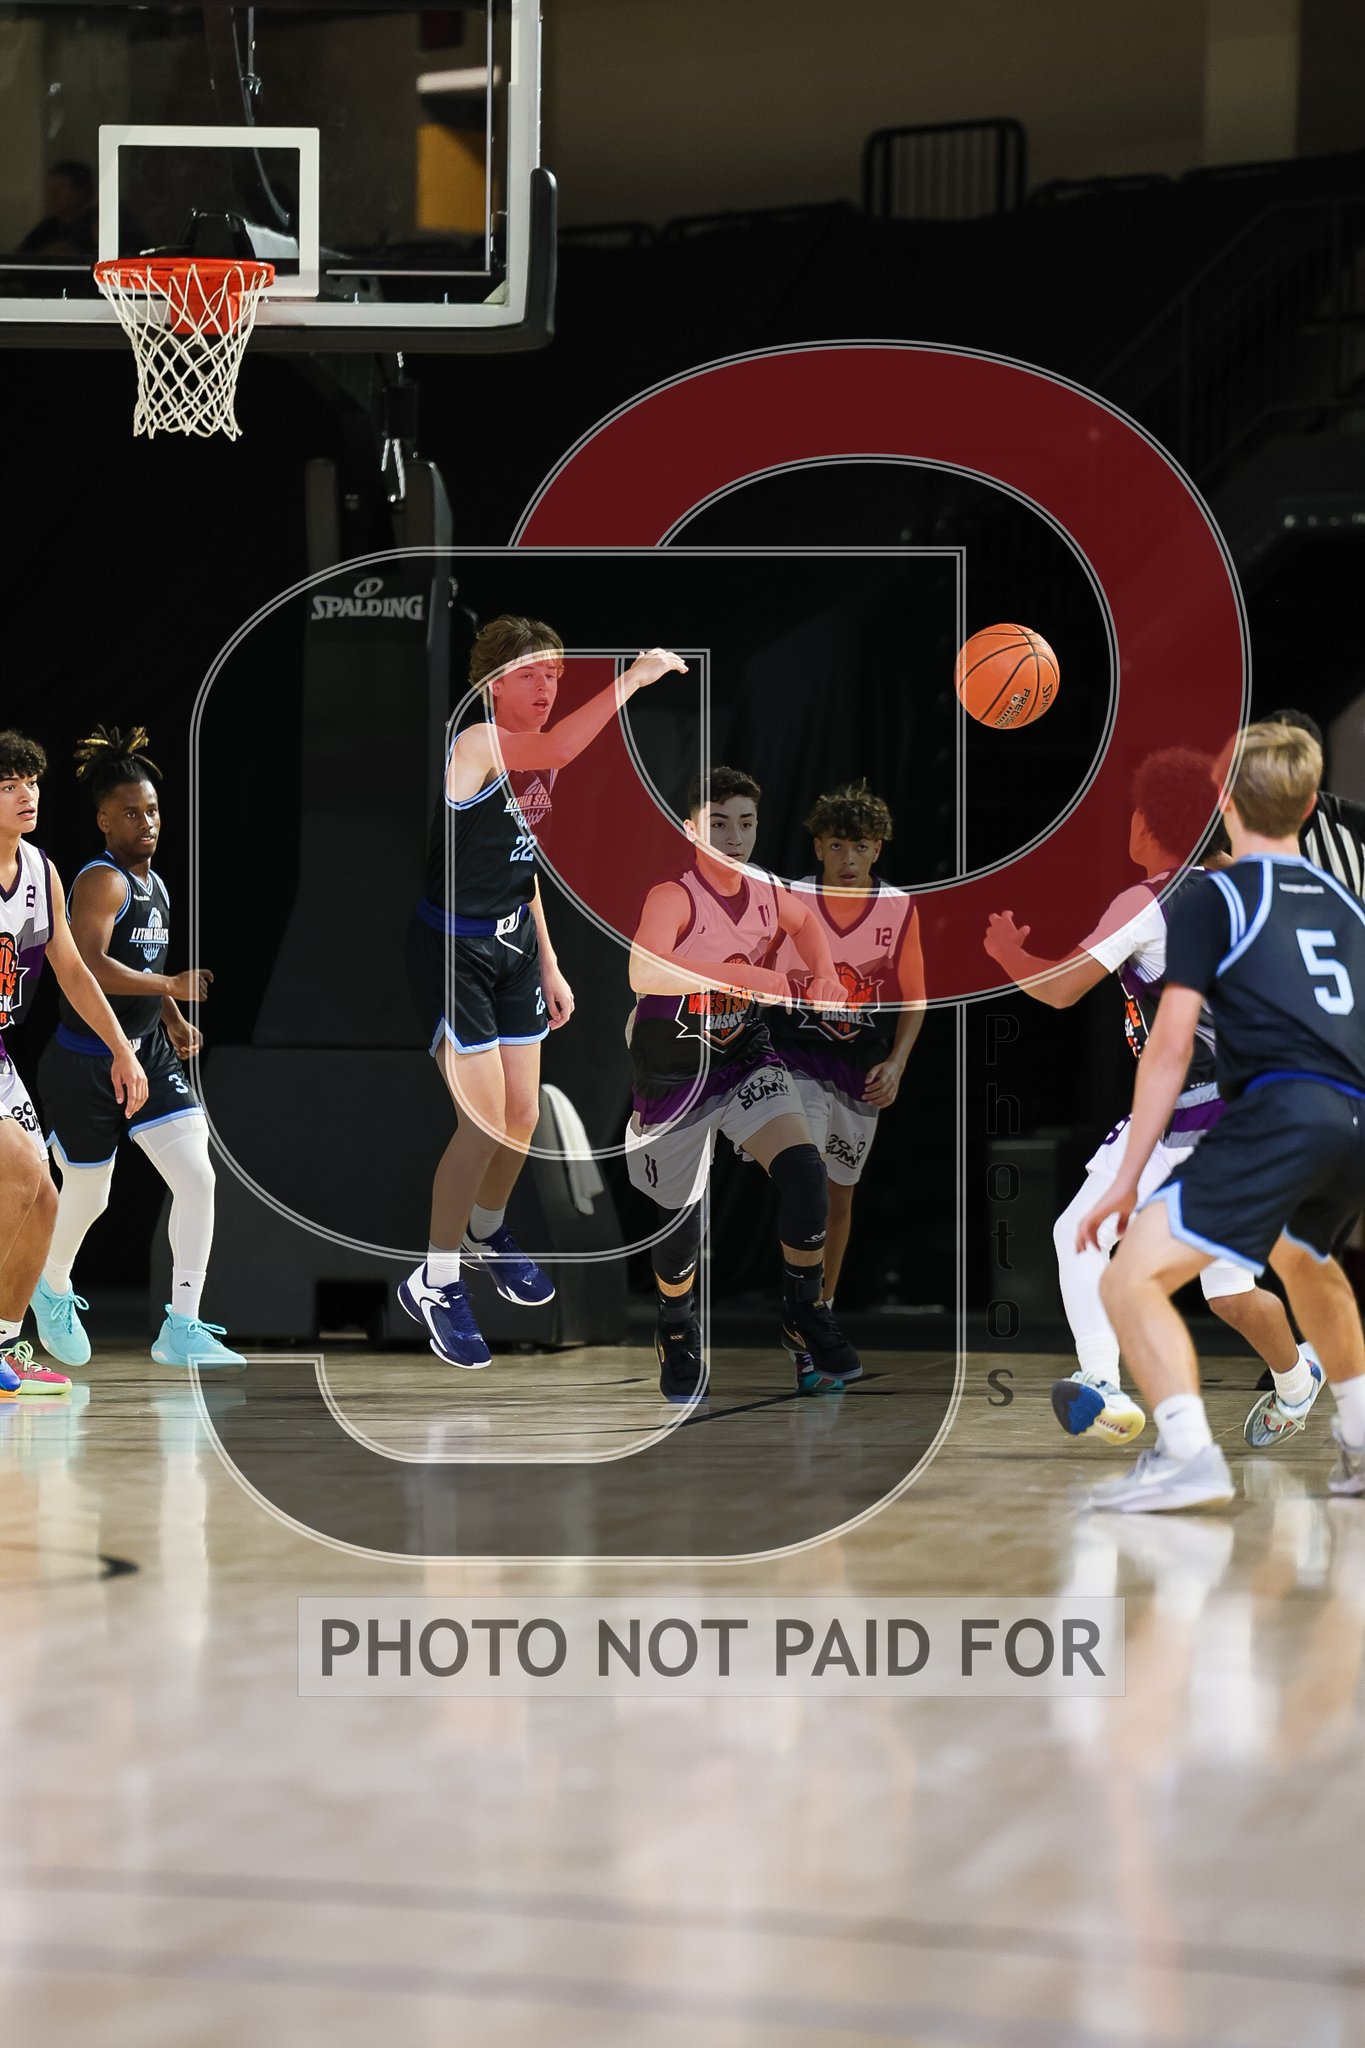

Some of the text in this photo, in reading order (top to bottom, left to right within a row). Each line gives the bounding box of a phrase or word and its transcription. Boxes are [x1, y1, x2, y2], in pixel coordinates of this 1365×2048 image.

[311, 595, 424, 620] SPALDING
[509, 833, 538, 862] 22
[874, 926, 893, 947] 12
[1296, 927, 1355, 1016] 5
[168, 1073, 188, 1094] 3
[740, 1081, 789, 1111] BUNNY
[644, 1152, 659, 1189] 11
